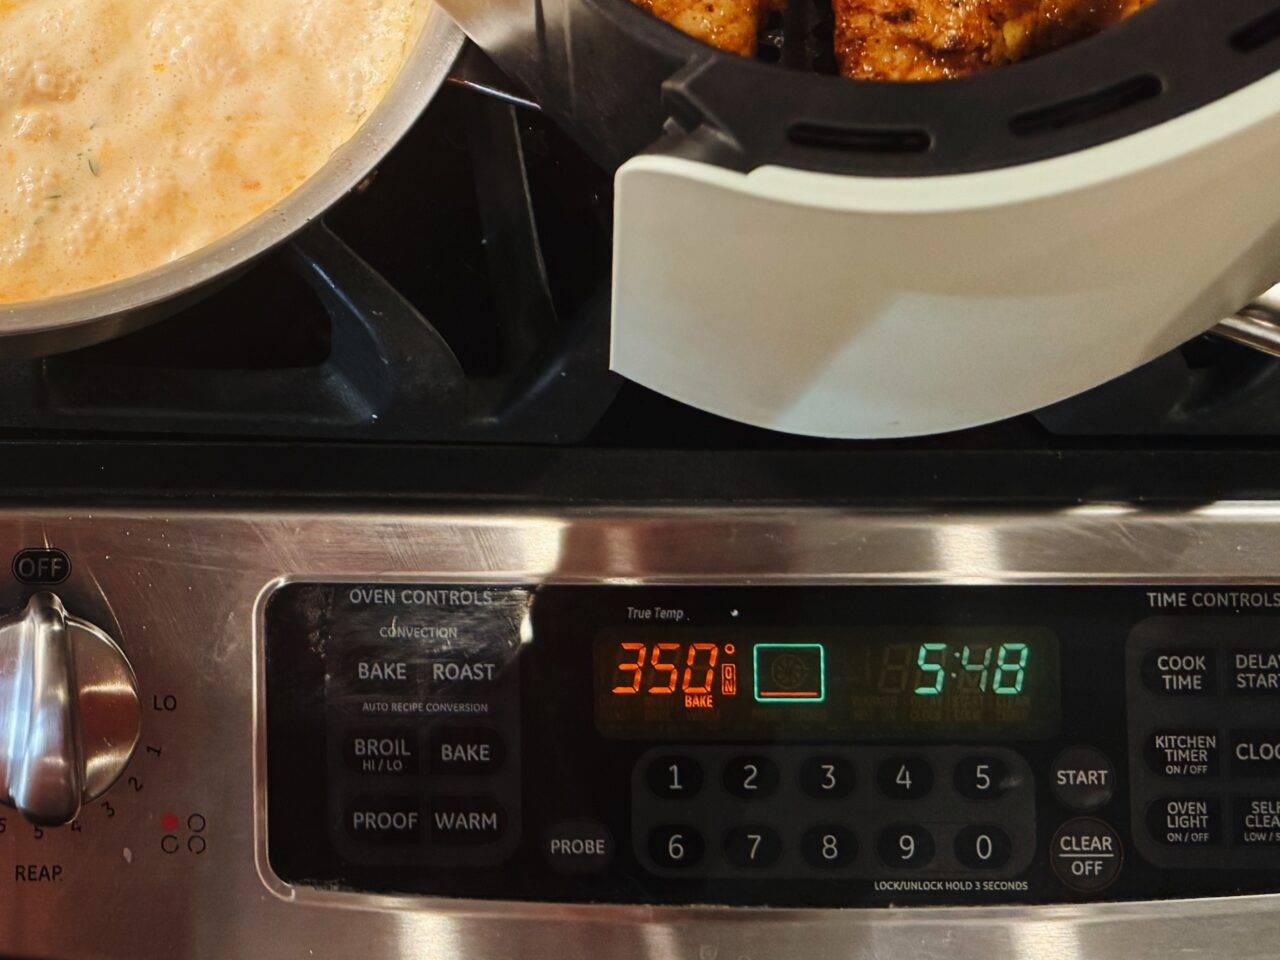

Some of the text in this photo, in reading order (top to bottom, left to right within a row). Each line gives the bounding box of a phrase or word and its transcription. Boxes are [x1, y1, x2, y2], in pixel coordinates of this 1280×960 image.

[20, 558, 63, 578] OFF
[349, 589, 493, 606] OVEN CONTROLS
[1146, 592, 1187, 607] TIME
[627, 606, 684, 621] True Temp
[379, 626, 458, 639] CONVECTION
[914, 643, 1029, 695] 5:48
[1157, 655, 1207, 671] COOK
[357, 662, 496, 681] BAKE ROAST
[1161, 674, 1203, 690] TIME
[153, 695, 177, 711] LO
[362, 702, 489, 713] AUTO RECIPE CONVERSION
[684, 695, 714, 708] BAKE
[354, 738, 411, 756] BROIL
[1155, 735, 1217, 749] KITCHEN
[147, 744, 161, 757] 1
[441, 744, 491, 762] BAKE
[1164, 749, 1208, 762] TIMER
[362, 760, 376, 772] HI
[385, 760, 403, 772] LO
[1165, 765, 1181, 775] ON
[1189, 765, 1208, 775] OFF
[128, 776, 142, 791] 2
[669, 764, 683, 789] 1
[744, 765, 758, 789] 2
[822, 765, 836, 789] 3
[895, 765, 912, 789] 4
[976, 765, 990, 790] 5
[1056, 770, 1108, 785] START
[101, 801, 116, 818] 3
[1167, 801, 1207, 815] OVEN
[353, 812, 418, 830] PROOF
[434, 813, 497, 830] WARM
[1166, 815, 1208, 828] LIGHT
[33, 823, 44, 839] 5
[1167, 832, 1182, 842] ON
[1190, 832, 1210, 842] OFF
[1243, 832, 1267, 842] LOW
[550, 839, 606, 855] PROBE
[669, 834, 684, 859] 6
[747, 834, 762, 859] 7
[822, 834, 838, 859] 8
[899, 834, 915, 859] 9
[976, 834, 992, 859] 0
[1060, 836, 1112, 851] CLEAR
[1071, 861, 1103, 876] OFF
[874, 881, 1029, 891] LOCK/UNLOCK HOLD 3 SECONDS
